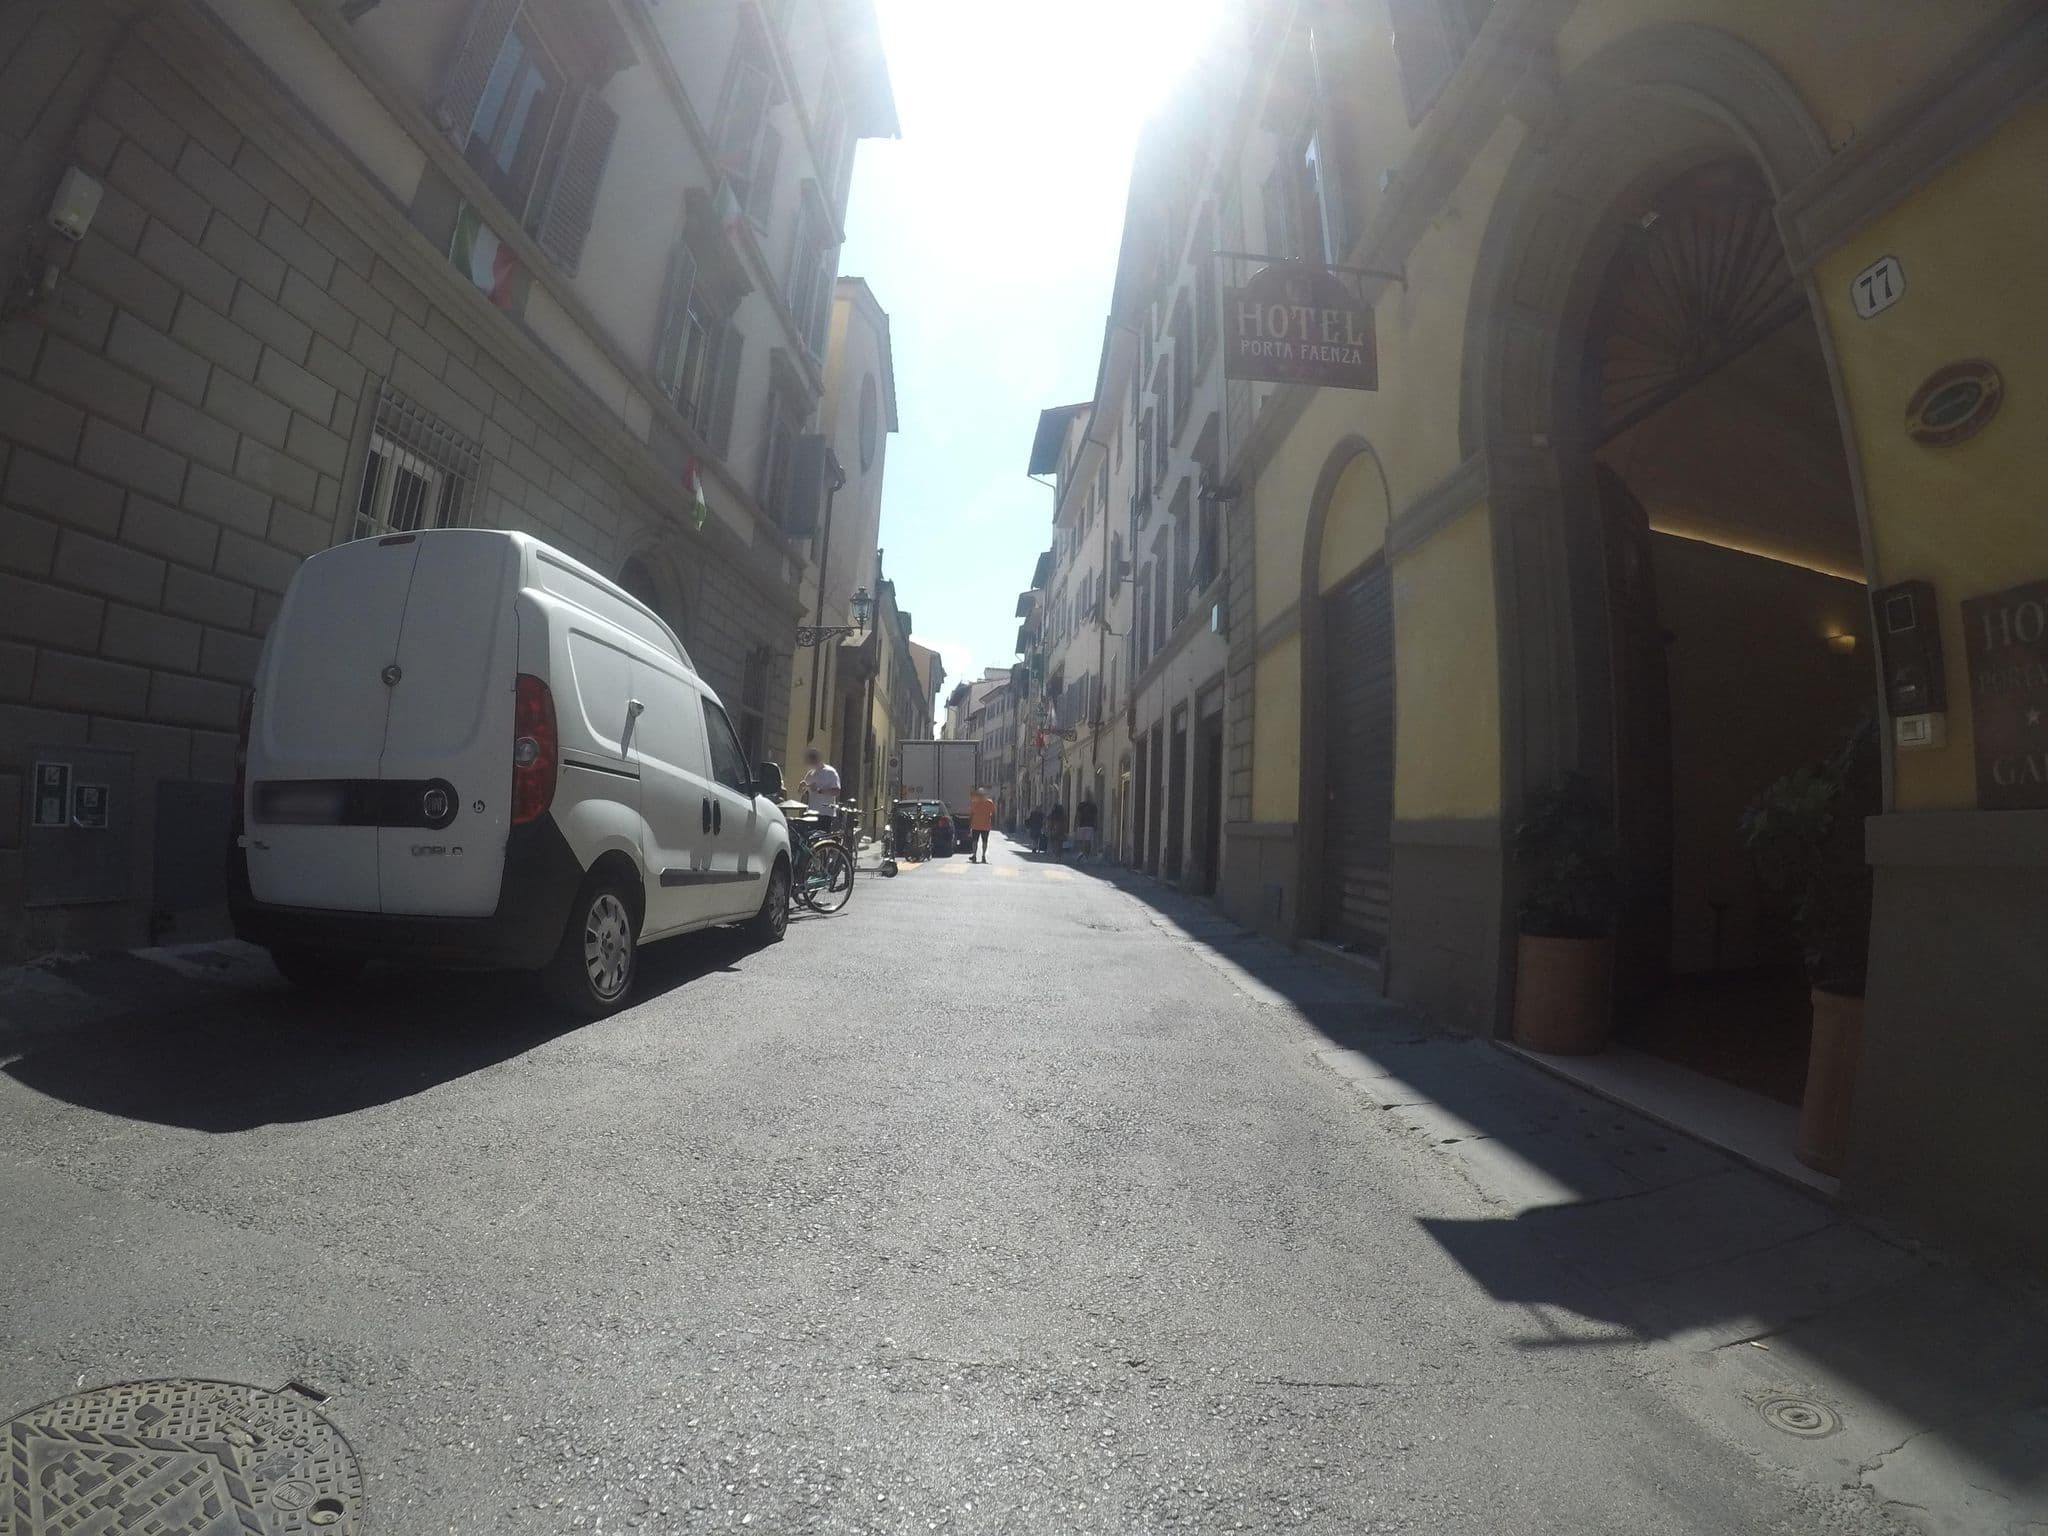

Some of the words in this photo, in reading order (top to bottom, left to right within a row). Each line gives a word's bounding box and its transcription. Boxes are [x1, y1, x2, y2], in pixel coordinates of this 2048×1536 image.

[1860, 264, 1892, 308] 77
[1238, 302, 1363, 344] HOTEL
[1240, 340, 1293, 359] PORTA
[1301, 345, 1362, 364] FAENZA
[1982, 598, 2048, 651] HO
[1991, 752, 2048, 786] GA
